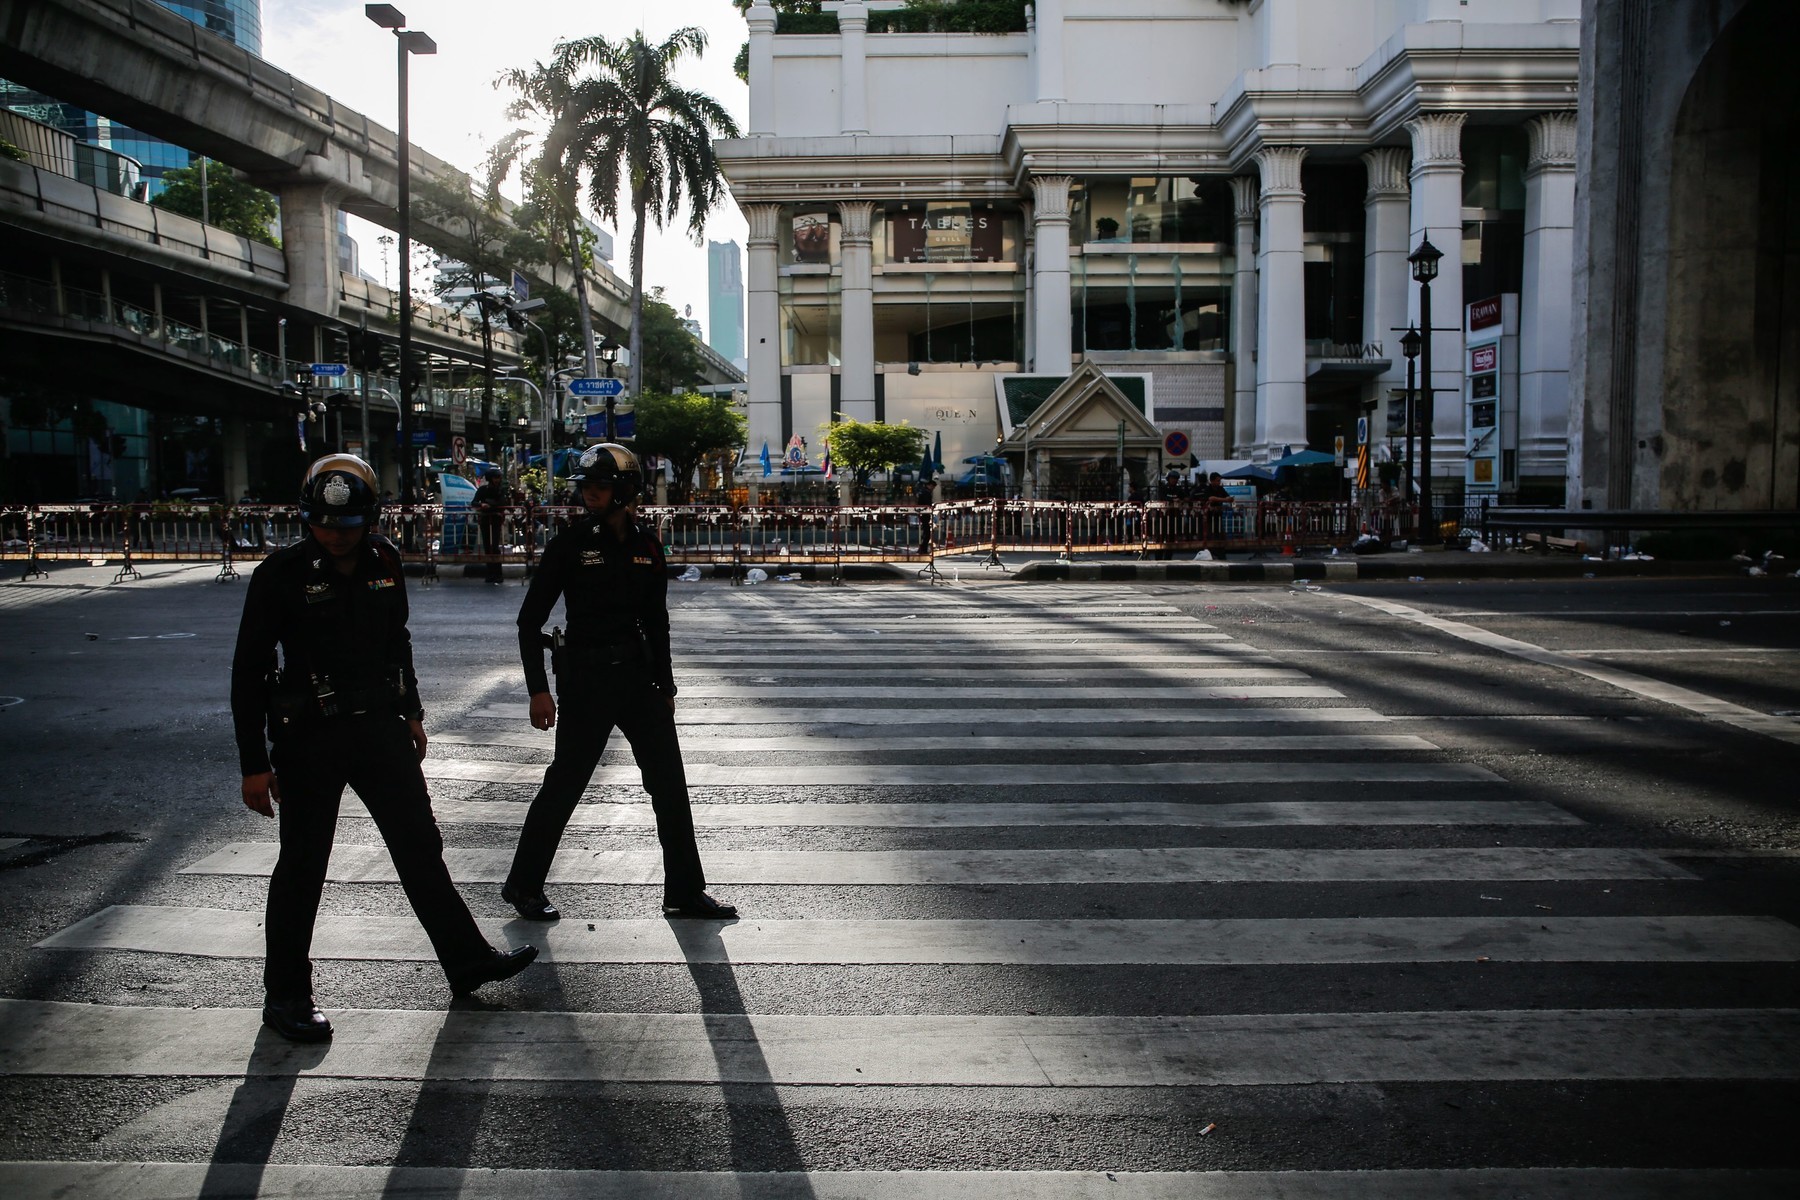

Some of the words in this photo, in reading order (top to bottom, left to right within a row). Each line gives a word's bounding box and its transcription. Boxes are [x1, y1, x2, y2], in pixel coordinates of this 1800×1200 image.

[908, 217, 988, 230] TABLES
[1472, 303, 1498, 321] ERAWAN
[585, 380, 614, 389] ราชดำริ
